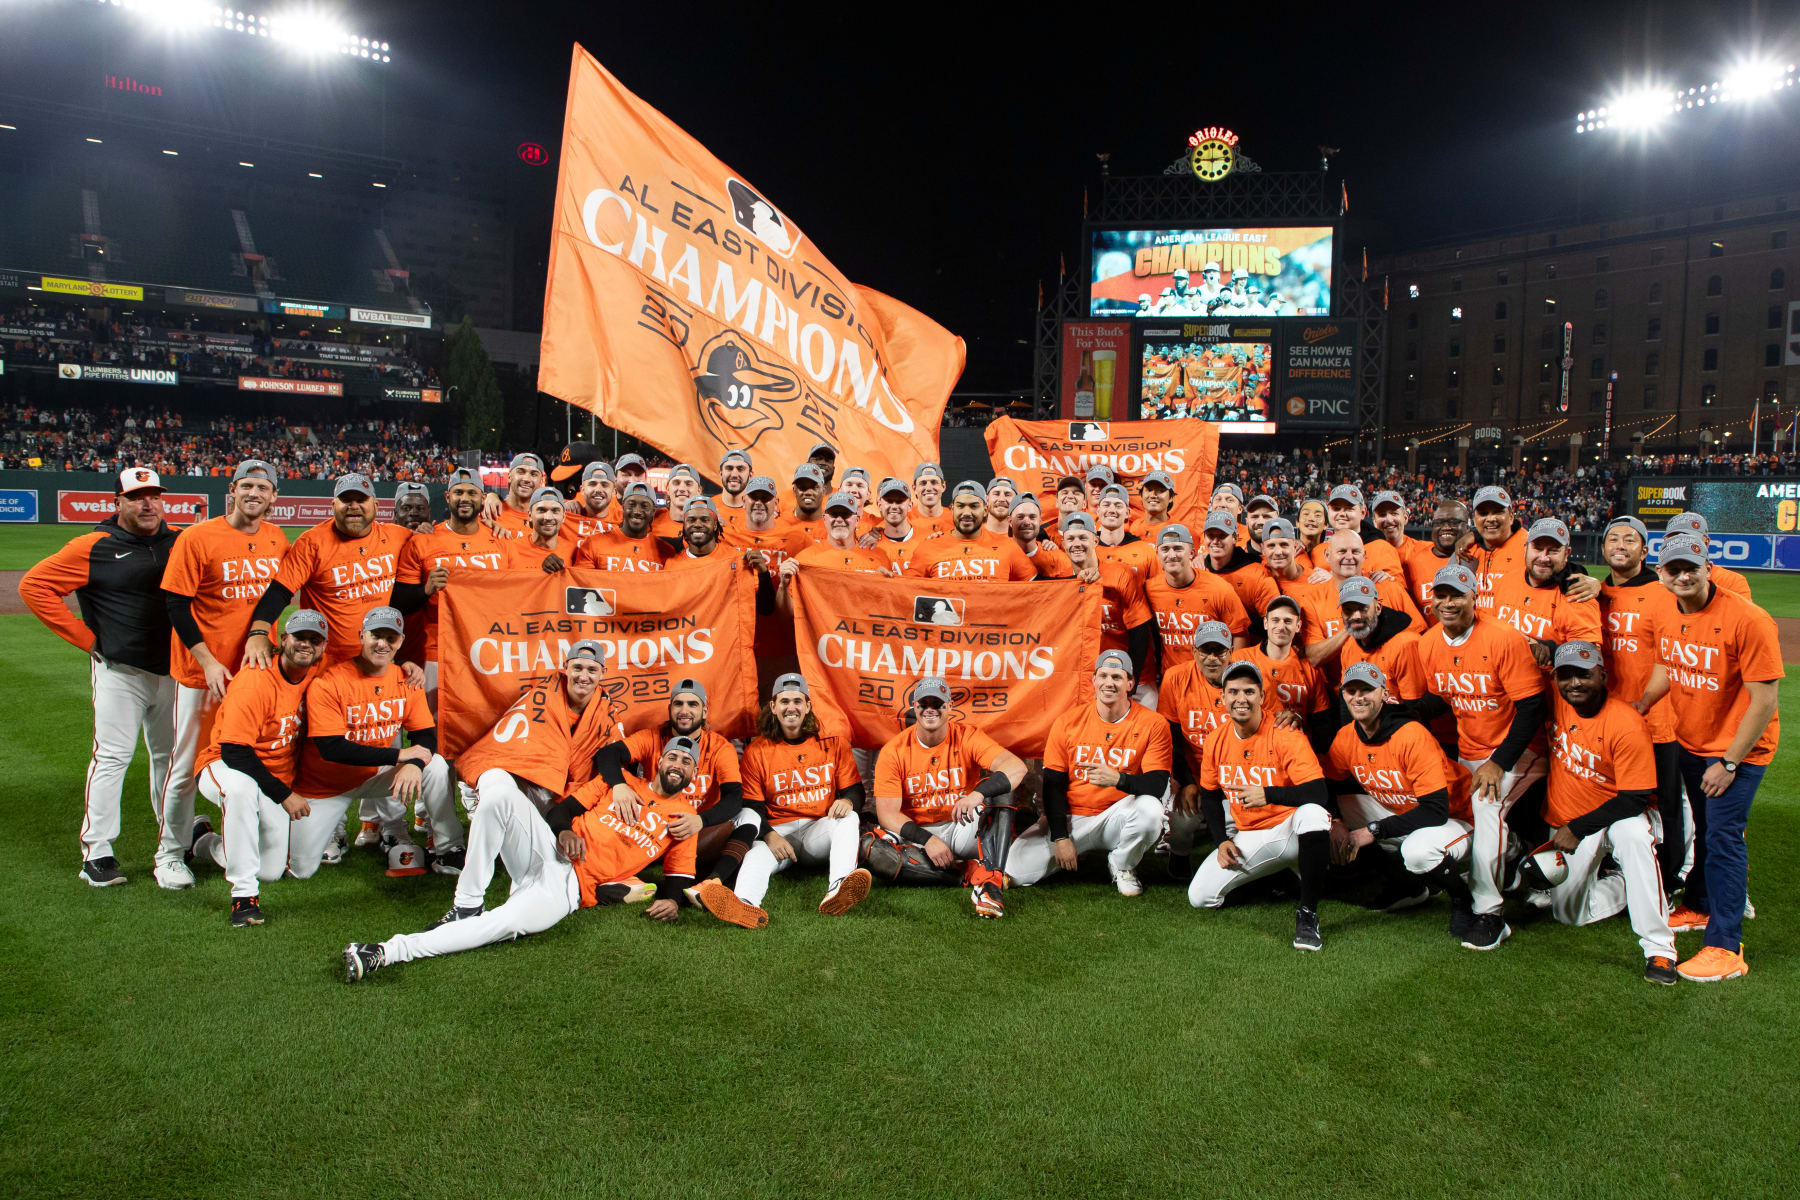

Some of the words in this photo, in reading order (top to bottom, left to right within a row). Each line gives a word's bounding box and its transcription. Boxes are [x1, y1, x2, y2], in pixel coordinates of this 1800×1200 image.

[104, 73, 162, 96] Hilton
[1188, 126, 1239, 146] ORIOLES
[1154, 235, 1202, 245] AMERICAN
[1205, 233, 1240, 242] LEAGUE
[1242, 233, 1267, 242] EAST
[1134, 243, 1282, 277] CHAMPIONS
[619, 175, 659, 214] AL
[672, 201, 759, 265] EAST
[766, 255, 887, 378] DIVISION
[47, 281, 88, 291] MARYLAND
[106, 288, 138, 296] LOTTERY
[359, 311, 391, 322] WBAL
[583, 188, 915, 433] CHAMPIONS
[1070, 326, 1094, 337] This
[1184, 324, 1231, 338] SUPERBOOK
[1303, 324, 1340, 343] Orioles
[1076, 338, 1092, 348] For
[1289, 346, 1308, 356] SEE
[1311, 346, 1334, 356] HOW
[1336, 346, 1353, 356] WE
[84, 365, 122, 374] PLUMBERS
[1289, 358, 1311, 367] CAN
[1312, 358, 1342, 367] MAKE
[1343, 358, 1351, 367] A
[101, 373, 129, 381] FITTERS
[130, 368, 176, 381] UNION
[1288, 368, 1352, 379] DIFFERENCE
[259, 380, 294, 390] JOHNSON
[296, 383, 325, 393] LUMBER
[1307, 399, 1350, 415] PNC
[1041, 441, 1089, 452] EAST
[1091, 439, 1173, 452] DIVISION
[1004, 447, 1187, 475] CHAMPIONS
[1638, 486, 1687, 500] SUPERBOOK
[70, 499, 116, 513] weis
[332, 553, 394, 586] EAST
[937, 558, 999, 578] EAST
[488, 621, 519, 635] AL
[526, 619, 588, 635] EAST
[592, 614, 697, 634] DIVISION
[1155, 611, 1209, 630] EAST
[1608, 612, 1640, 633] ST
[835, 620, 865, 635] AL
[872, 624, 933, 641] EAST
[940, 630, 1041, 645] DIVISION
[817, 633, 1055, 681] CHAMPIONS
[1660, 637, 1719, 670] EAST
[632, 678, 671, 698] 23
[1434, 672, 1491, 694] EAST
[858, 683, 894, 701] 20
[972, 692, 1008, 708] 23
[1277, 684, 1306, 703] ST
[346, 698, 407, 726] EAST
[1075, 745, 1137, 768] EAST
[773, 763, 834, 792] EAST
[906, 767, 963, 795] EAST
[1219, 765, 1277, 787] EAST
[1353, 765, 1405, 790] EAST
[600, 814, 659, 858] CHAMPS
